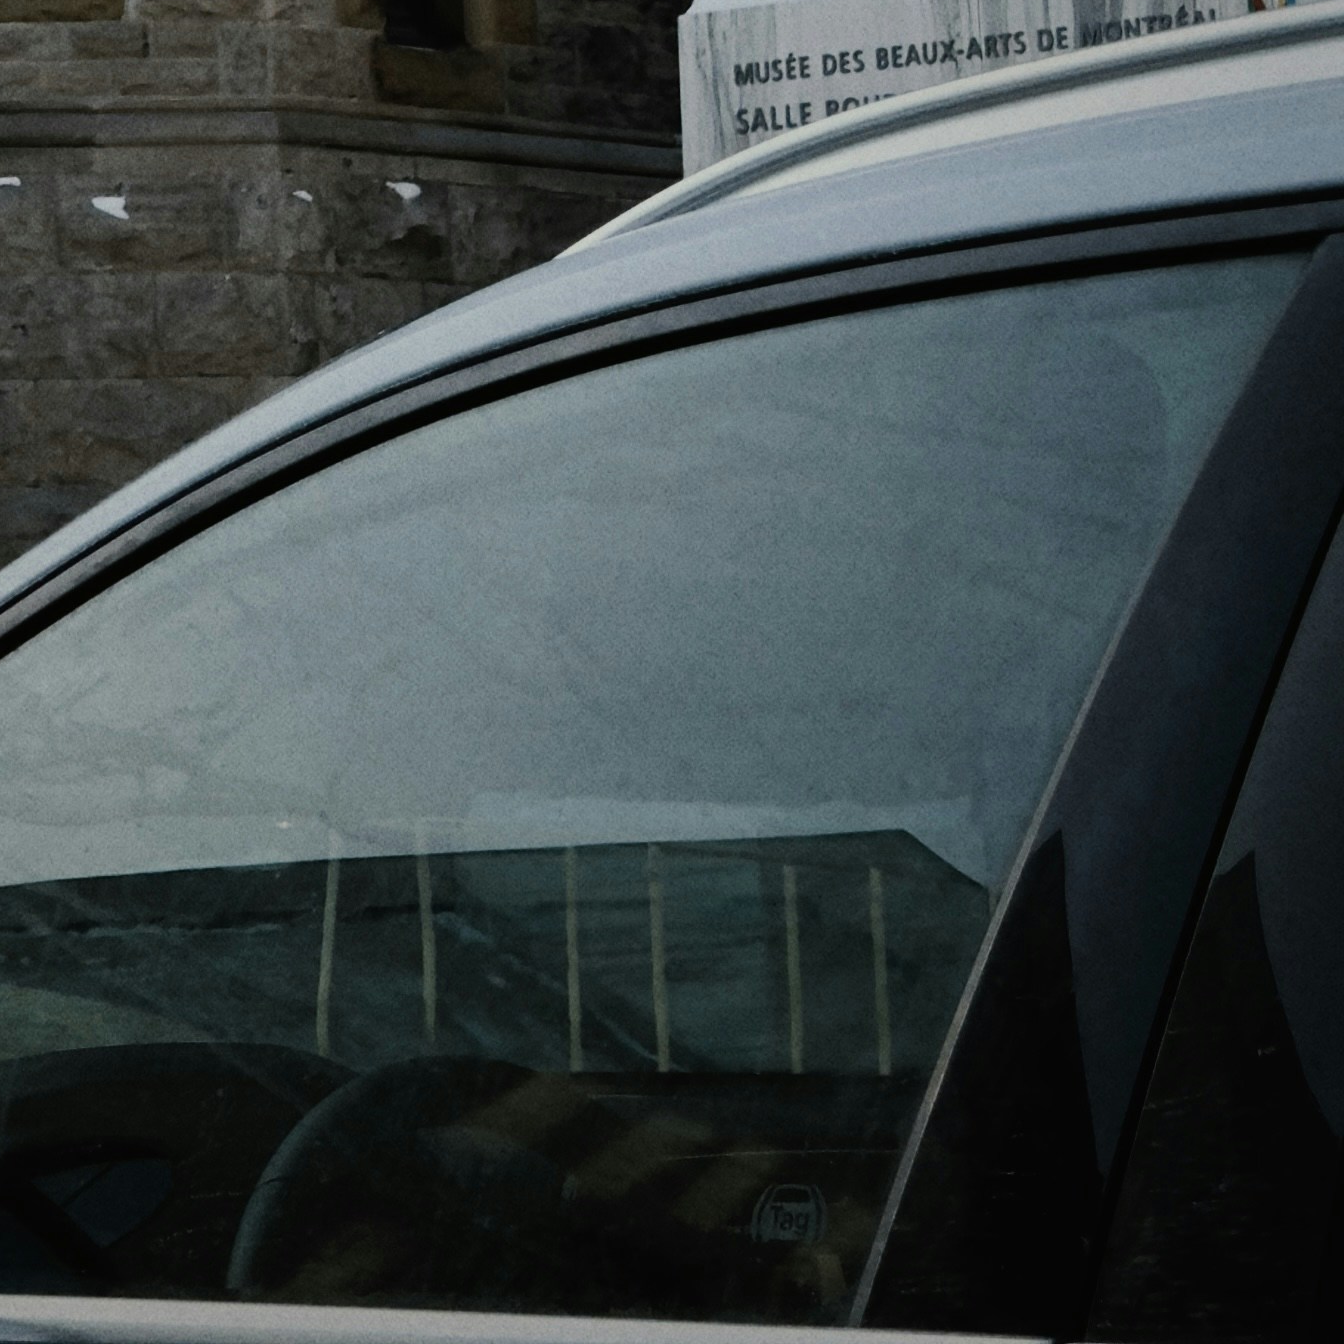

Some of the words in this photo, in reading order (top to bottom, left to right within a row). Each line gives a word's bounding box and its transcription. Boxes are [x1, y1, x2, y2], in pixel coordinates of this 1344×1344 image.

[734, 53, 810, 86] MUSÉE
[822, 50, 865, 76] DES
[875, 30, 1026, 71] BEAUX-ARTS
[1037, 26, 1068, 53] DE
[736, 102, 812, 135] SALLE
[770, 1205, 809, 1237] Tag
